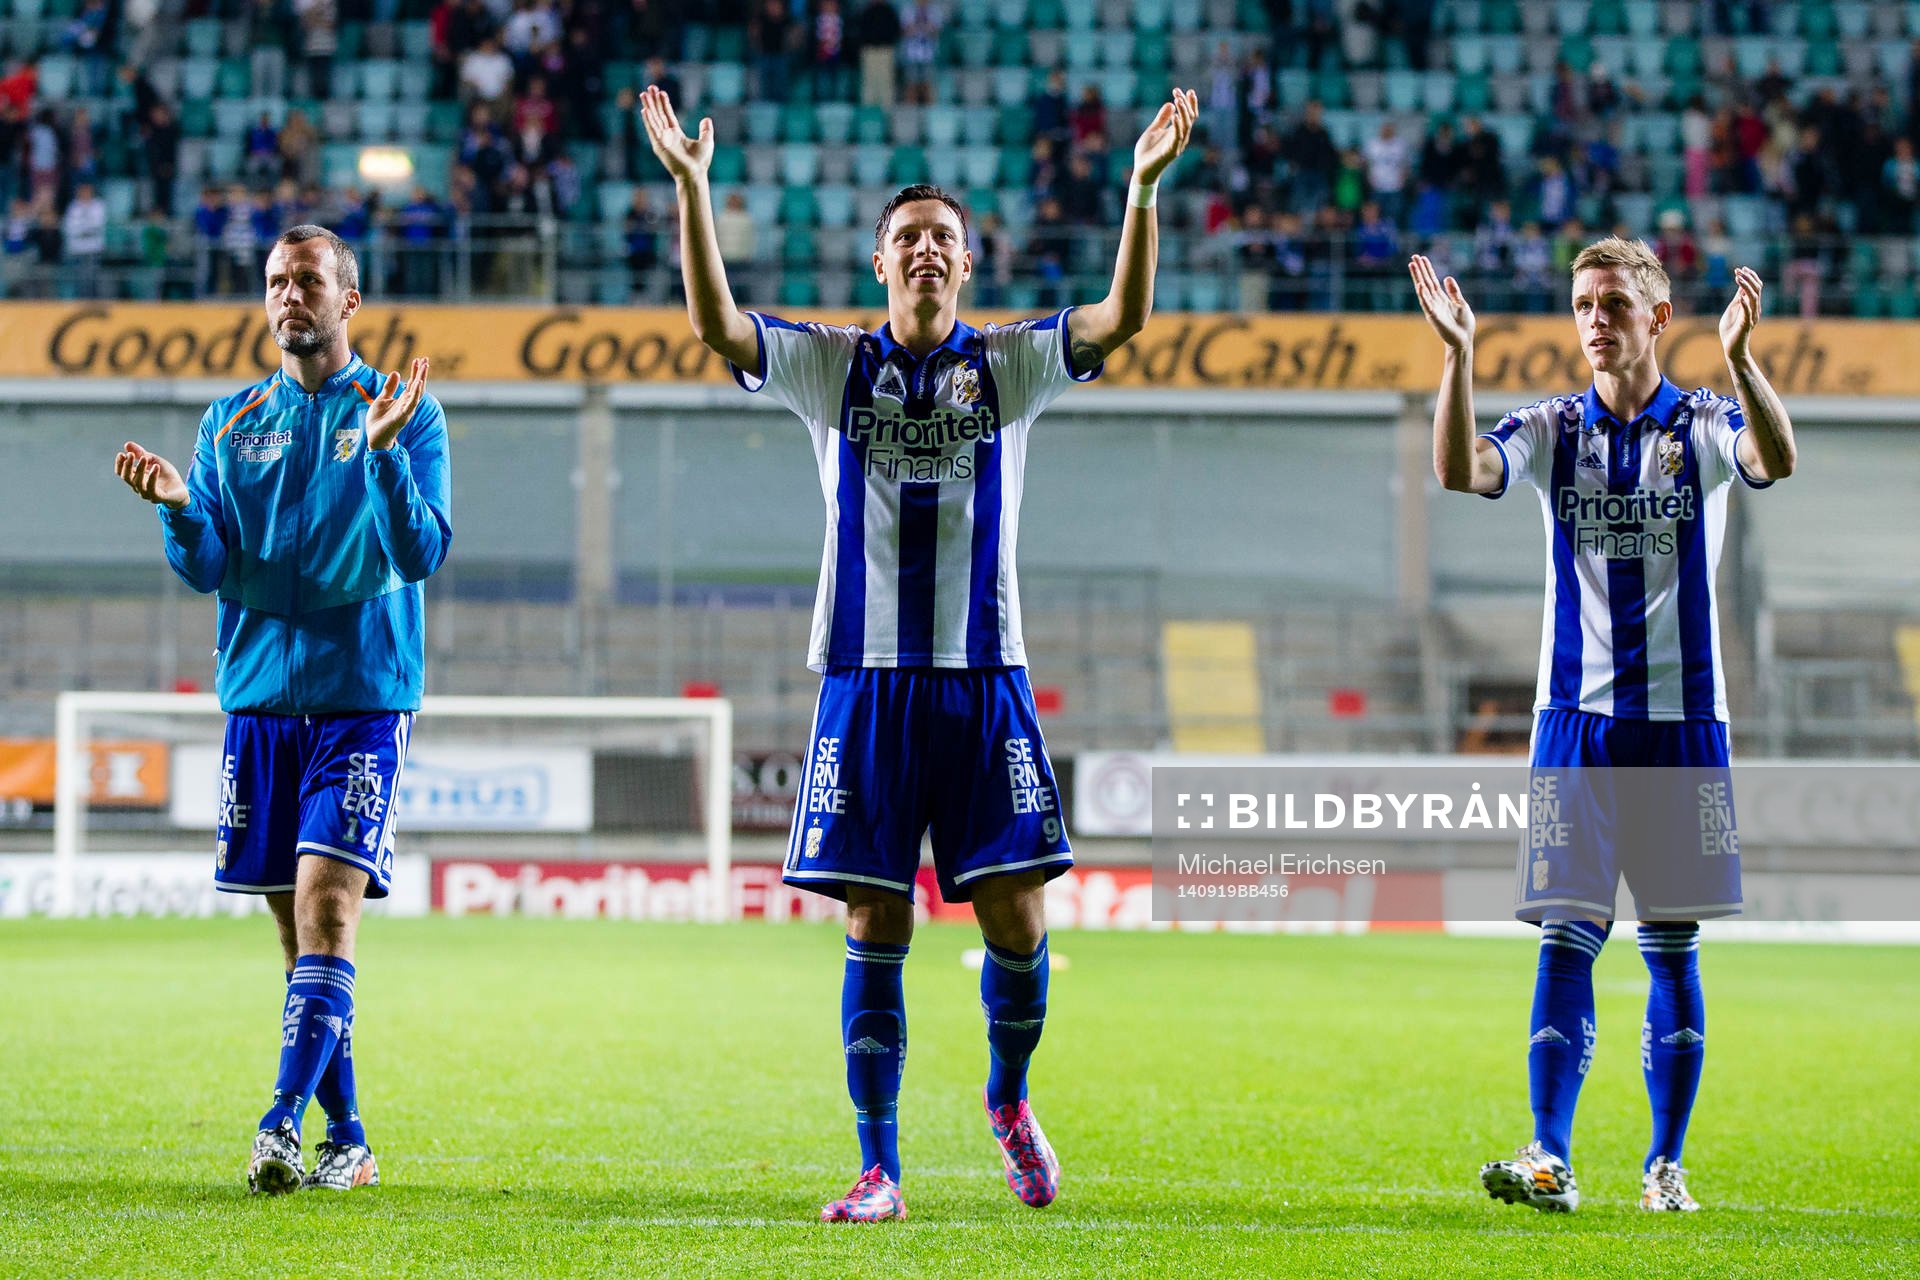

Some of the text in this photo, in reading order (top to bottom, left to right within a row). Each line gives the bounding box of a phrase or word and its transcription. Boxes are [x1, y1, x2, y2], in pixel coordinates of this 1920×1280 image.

[230, 429, 292, 447] Prioritet
[847, 406, 995, 448] Prioritet
[238, 447, 282, 462] Finans
[866, 446, 975, 482] Finans
[1558, 486, 1694, 523] Prioritet
[1576, 526, 1676, 559] Finans
[817, 737, 840, 762] SE
[1004, 738, 1033, 764] SE
[347, 752, 378, 777] SE
[812, 762, 839, 787] RN
[1007, 763, 1041, 789] RN
[809, 787, 847, 814] EKE
[1010, 786, 1055, 815] EKE
[1532, 776, 1558, 800] SE
[1697, 782, 1726, 807] SE
[342, 791, 386, 822] EKE
[1531, 799, 1560, 824] RN
[1700, 806, 1732, 831] RN
[343, 816, 379, 852] 14
[1042, 817, 1061, 844] 9
[1531, 822, 1569, 849] EKE
